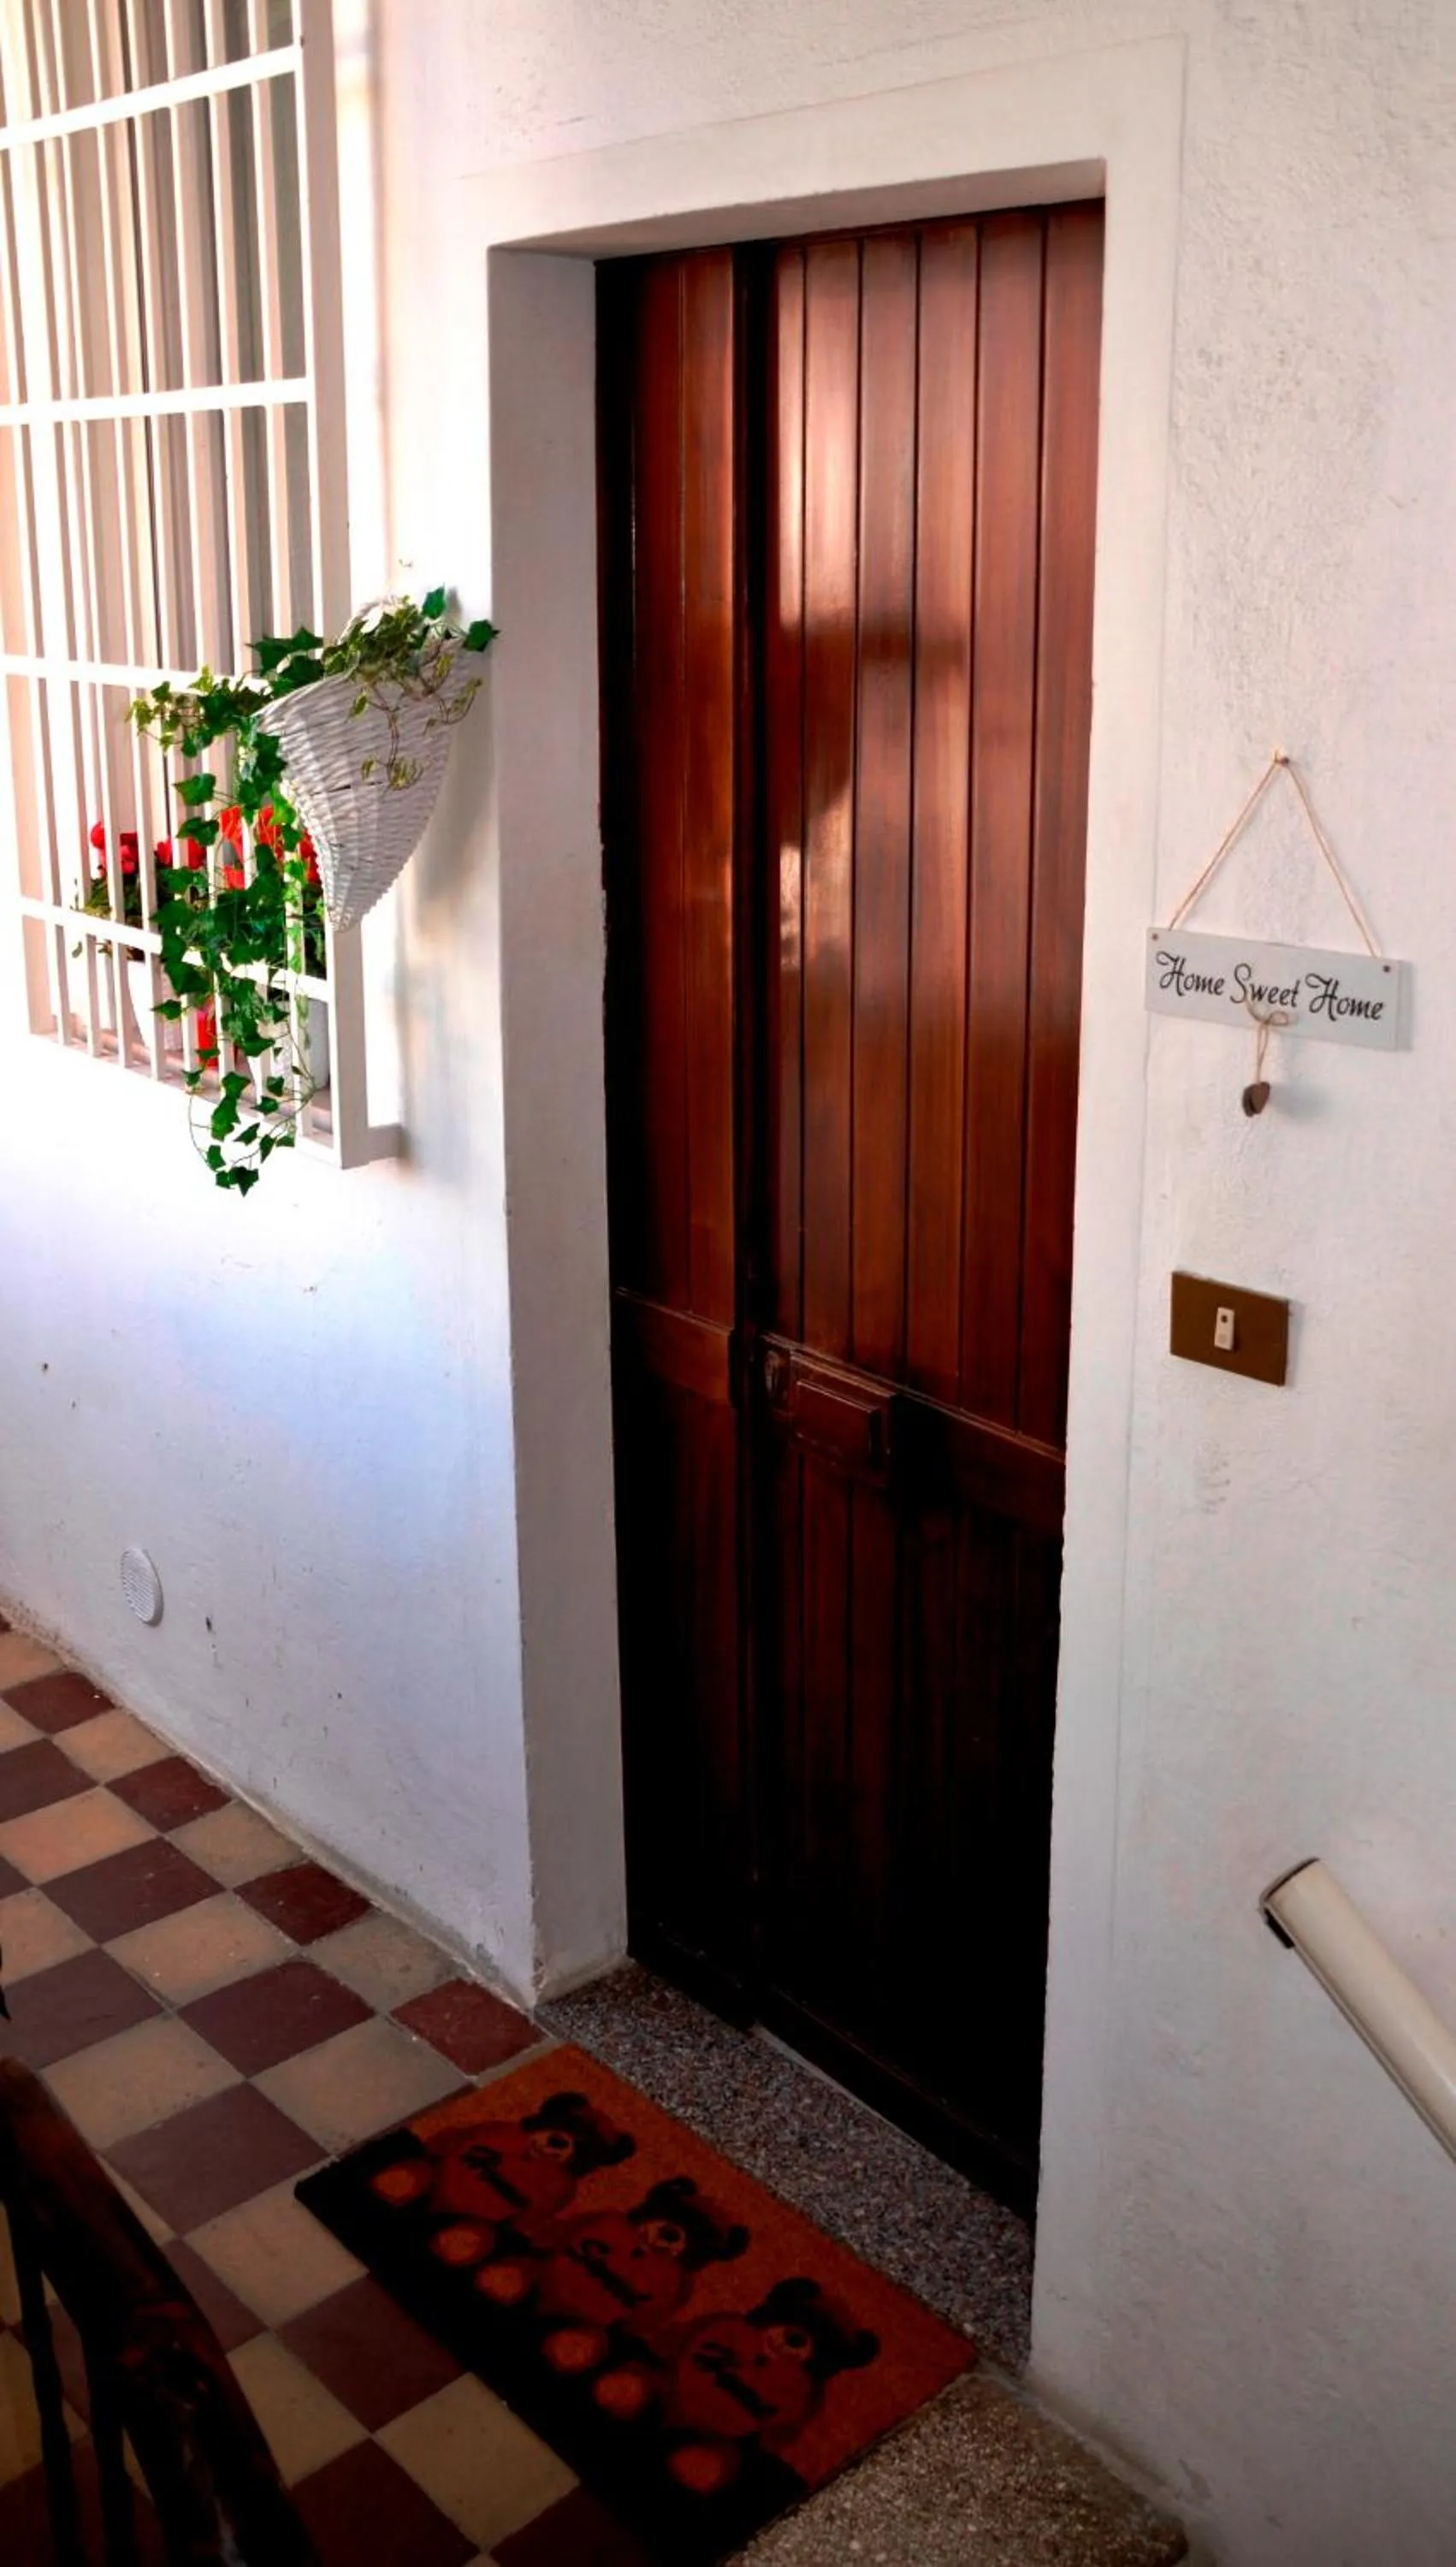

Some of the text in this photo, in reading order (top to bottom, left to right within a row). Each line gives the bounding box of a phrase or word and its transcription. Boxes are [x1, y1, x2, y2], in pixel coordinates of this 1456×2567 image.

[1156, 951, 1384, 1022] Home Sweet Home
